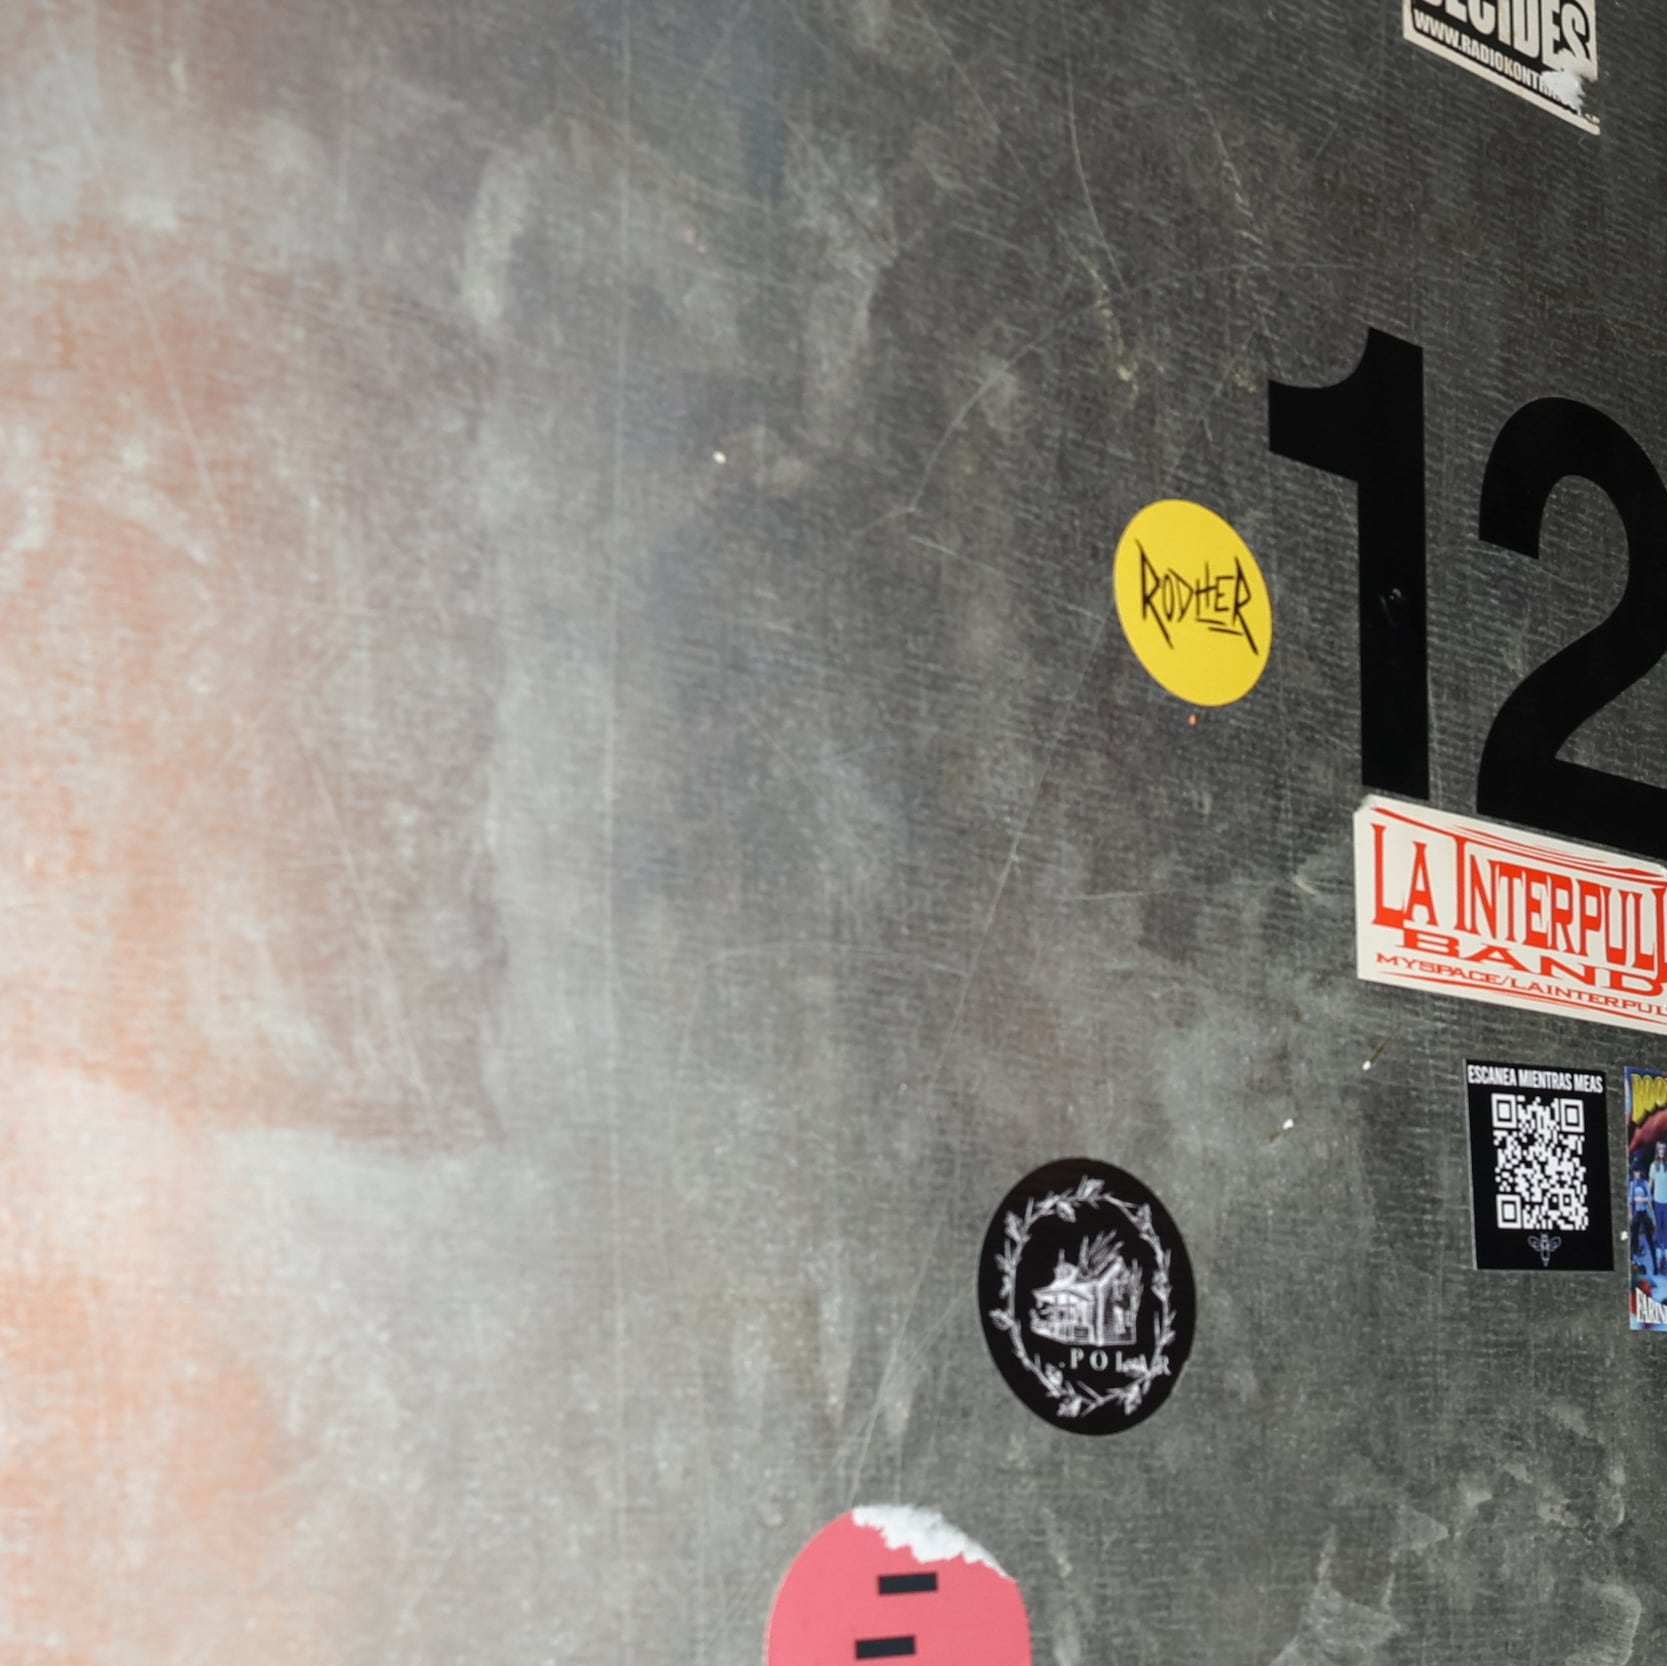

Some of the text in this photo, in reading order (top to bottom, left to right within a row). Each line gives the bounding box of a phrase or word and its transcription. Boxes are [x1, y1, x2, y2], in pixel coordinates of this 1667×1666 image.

[1135, 538, 1259, 656] RODHER
[1371, 823, 1439, 929] LA
[1395, 929, 1664, 996] BAND
[1467, 1064, 1604, 1094] ESCANEA MIENTRAS MEAS
